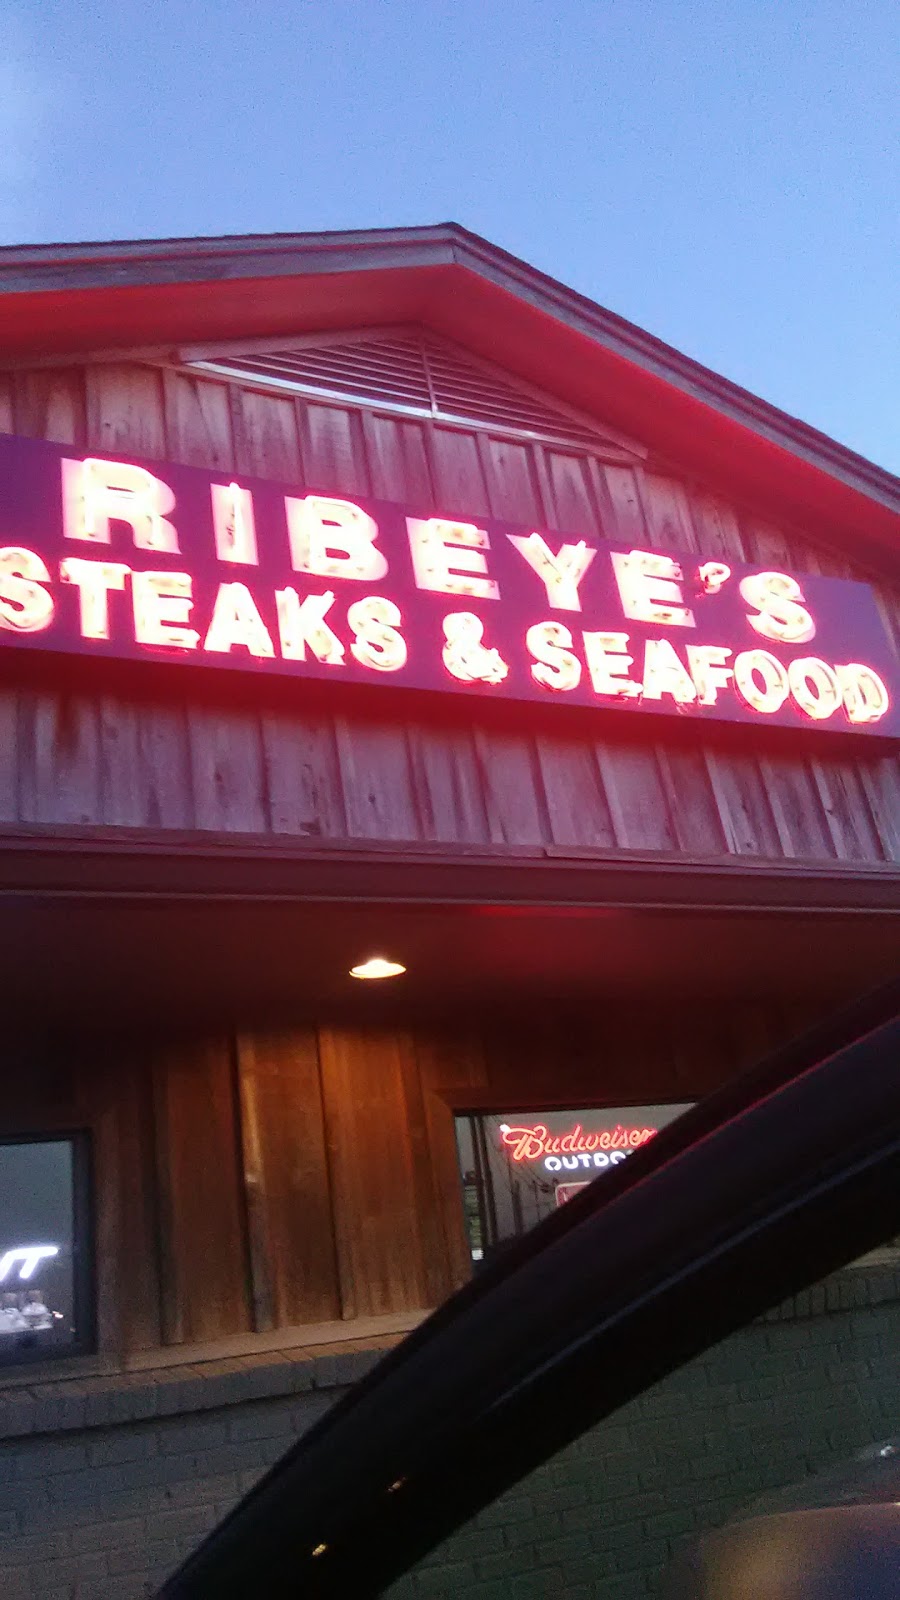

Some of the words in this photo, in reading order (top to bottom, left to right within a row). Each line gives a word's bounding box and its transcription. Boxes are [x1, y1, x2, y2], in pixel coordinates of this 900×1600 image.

[0, 547, 408, 672] STEAKS
[441, 611, 508, 684] &
[525, 621, 889, 723] SEAFOOD
[61, 457, 816, 643] RIBEYE'S
